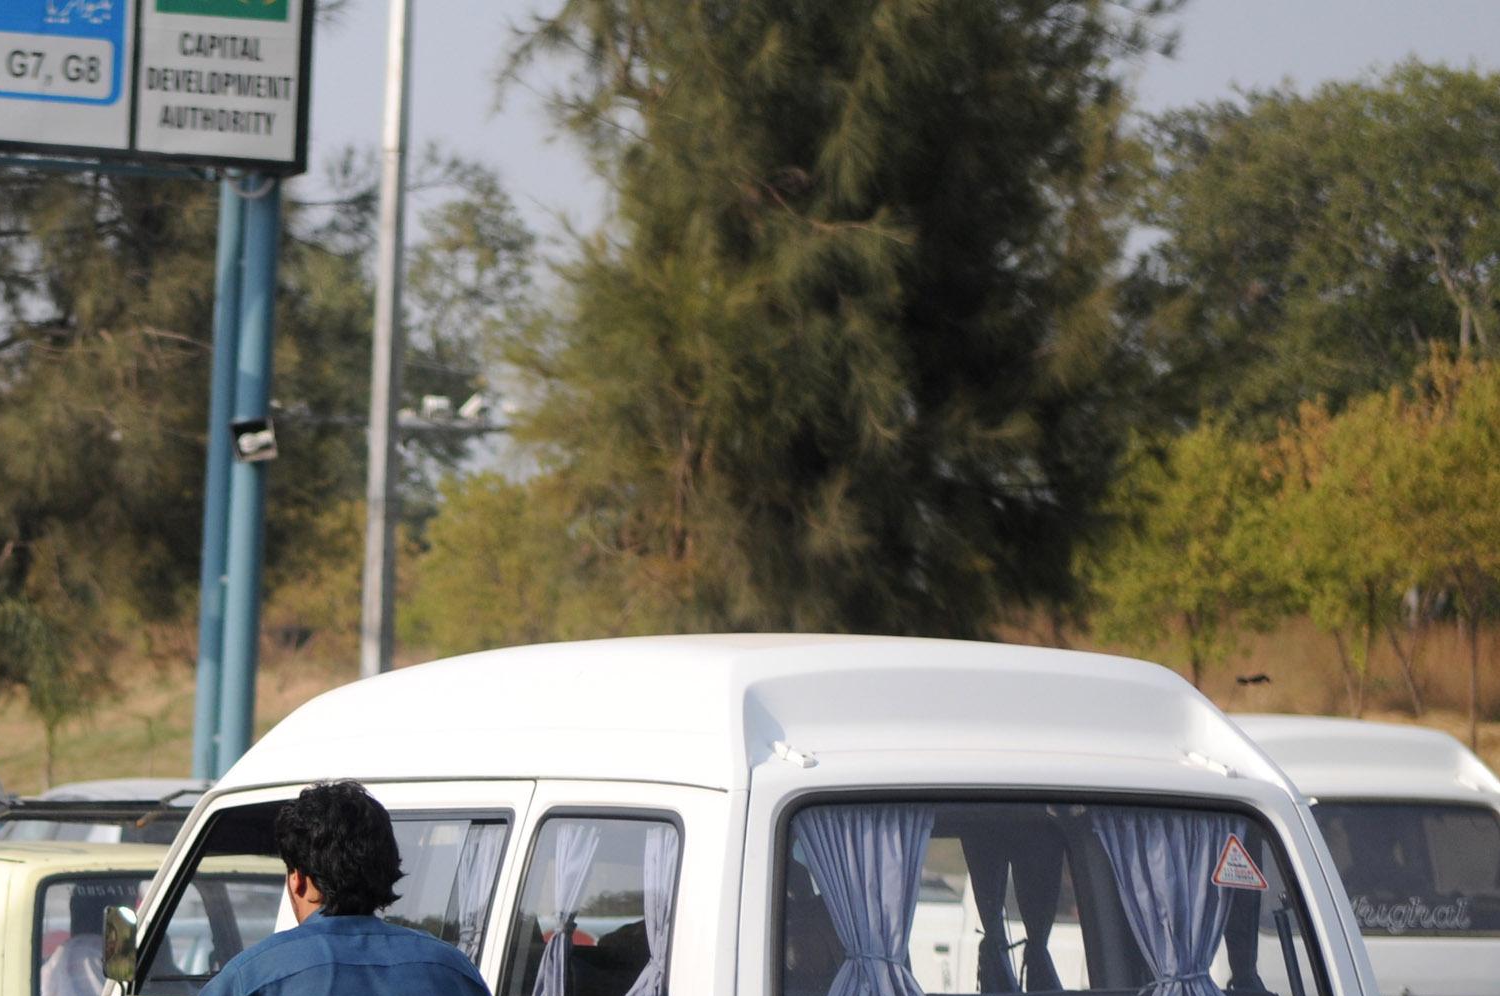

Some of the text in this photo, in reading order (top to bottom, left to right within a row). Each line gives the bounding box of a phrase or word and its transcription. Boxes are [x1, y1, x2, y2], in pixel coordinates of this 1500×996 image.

[179, 32, 263, 62] CAPITAL
[6, 50, 53, 86] G7,
[62, 54, 101, 84] G8
[147, 67, 293, 100] DEVELOPMENT
[159, 105, 276, 136] AUTHORITY
